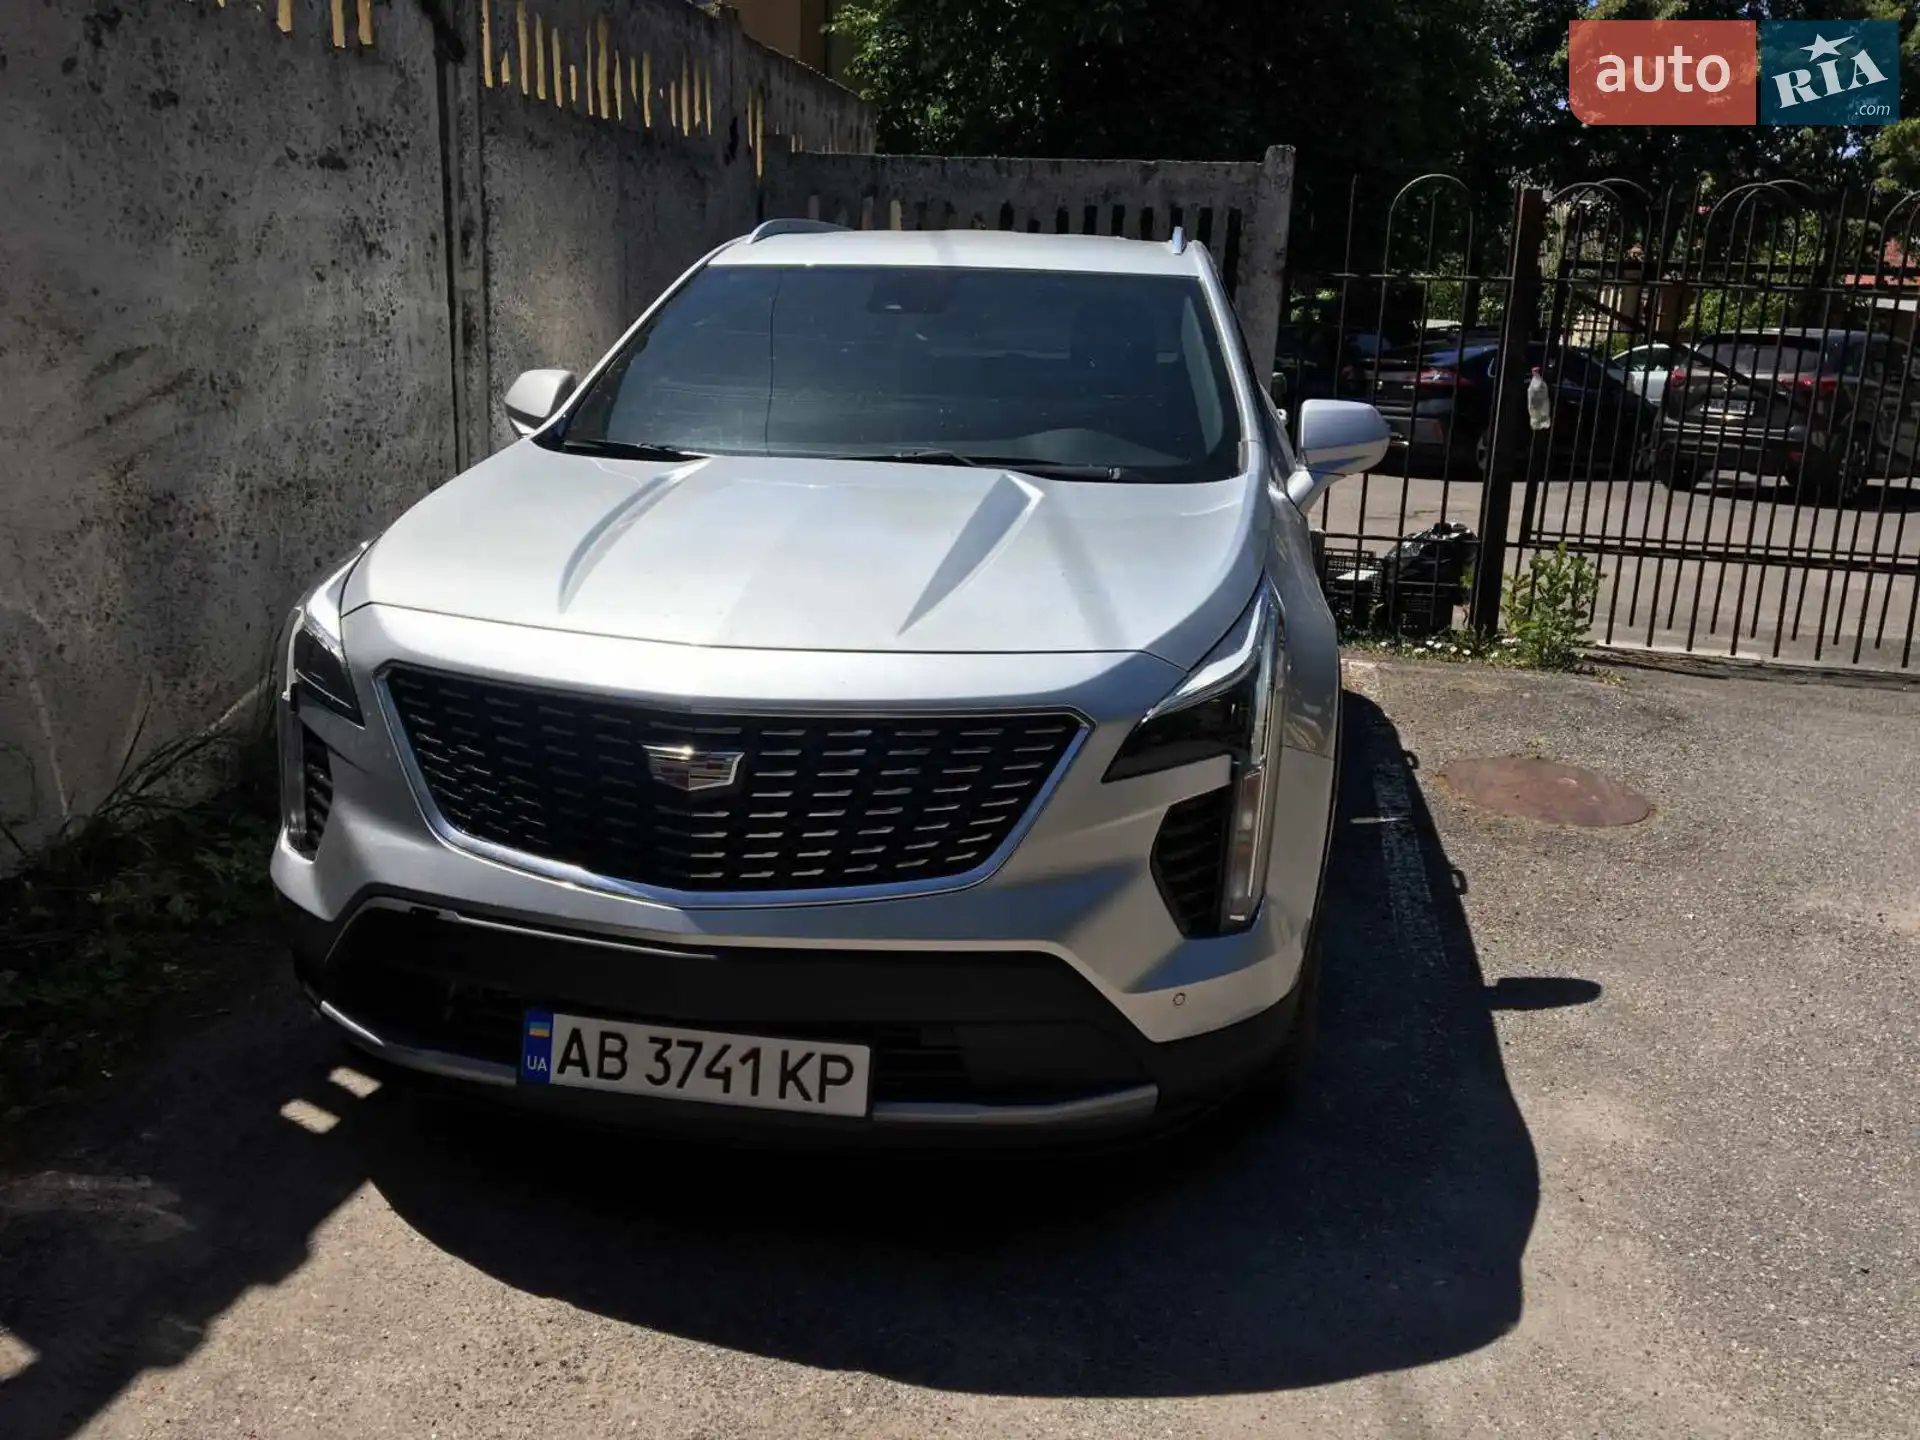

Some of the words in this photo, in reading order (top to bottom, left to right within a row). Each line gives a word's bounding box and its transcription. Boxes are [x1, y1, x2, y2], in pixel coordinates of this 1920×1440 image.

[527, 1056, 547, 1073] UA
[556, 1027, 628, 1082] AB
[645, 1036, 761, 1098] 3741
[777, 1049, 854, 1104] KP
